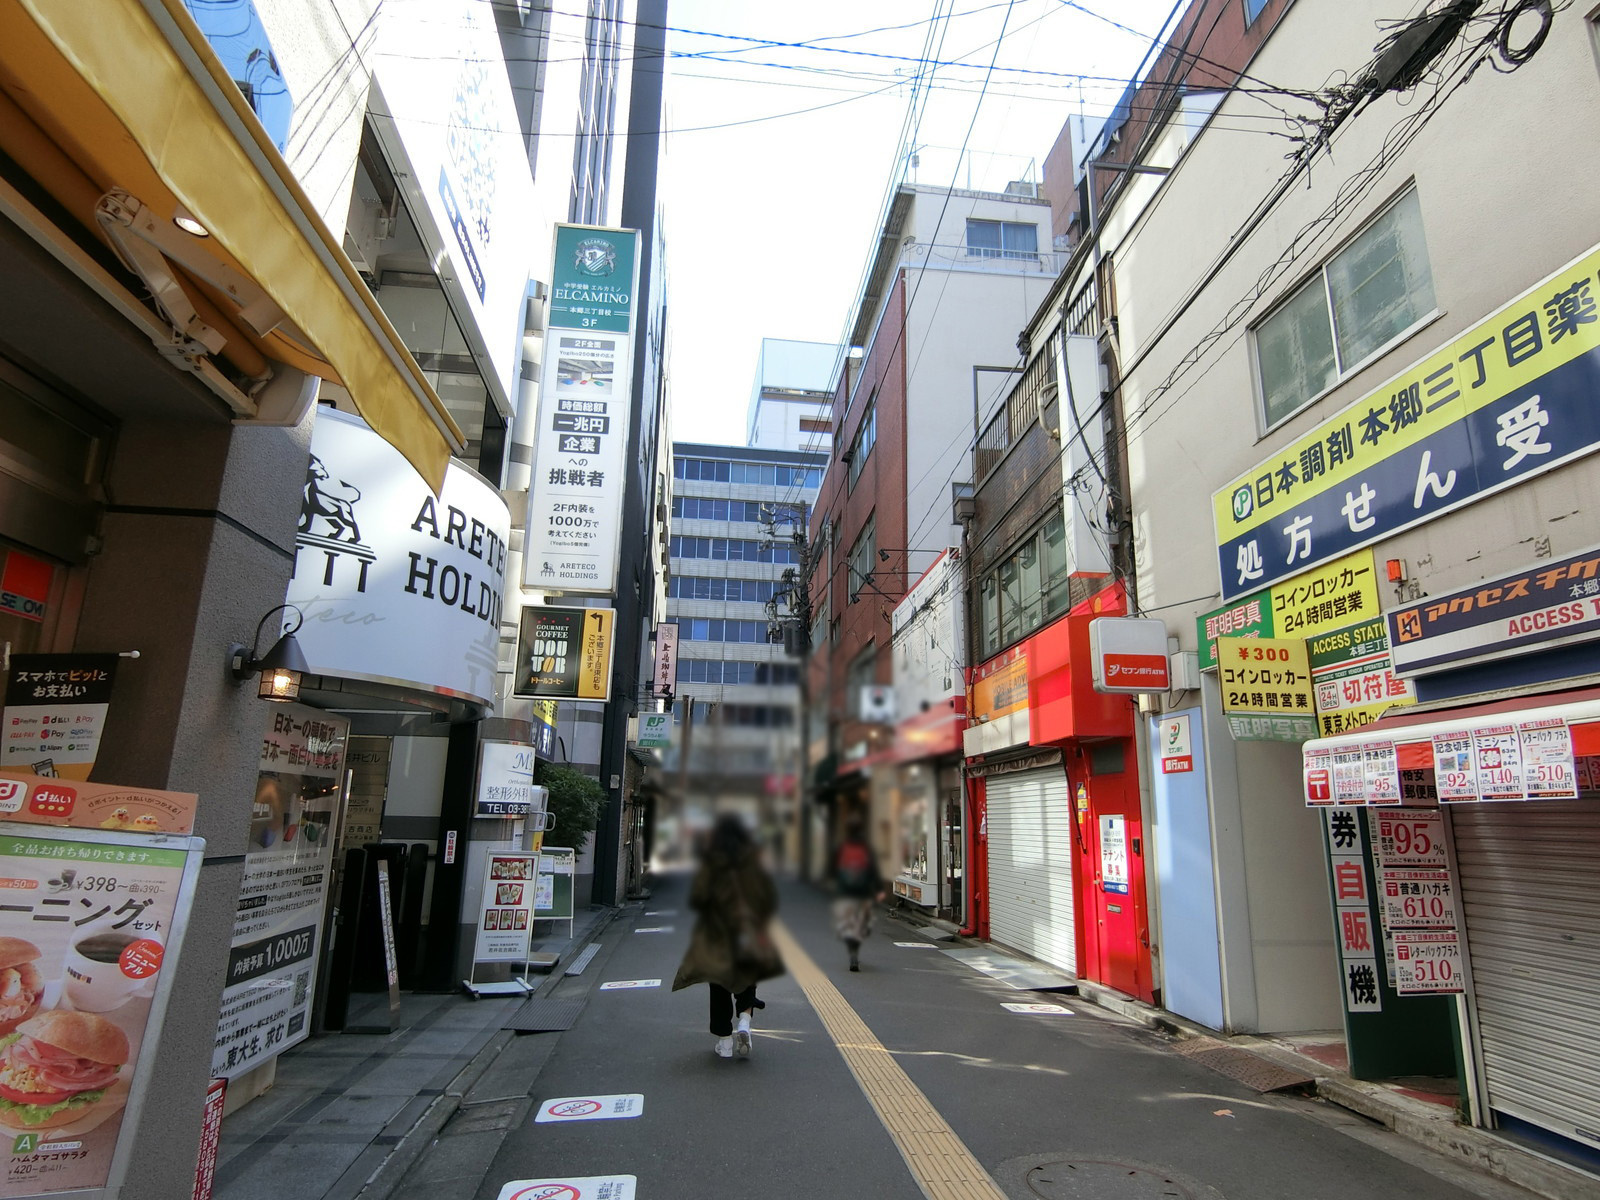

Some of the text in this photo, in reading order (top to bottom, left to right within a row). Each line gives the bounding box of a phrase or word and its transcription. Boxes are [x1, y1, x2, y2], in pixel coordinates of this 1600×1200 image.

[555, 288, 629, 305] ELCAMINO
[569, 306, 612, 317] 本郷三丁目校
[581, 318, 598, 327] 3F
[574, 339, 602, 349] 2F全面
[1254, 271, 1600, 509] 日本調剤 本郷三丁目薬
[561, 401, 605, 413] 時価総額
[557, 417, 605, 432] 一兆円
[563, 436, 596, 453] 企業
[568, 458, 588, 466] への
[548, 468, 605, 488] 挑戦者
[1236, 394, 1552, 586] 処方せん受
[552, 503, 595, 514] 2F内装を
[548, 516, 599, 528] 1000万で
[548, 530, 597, 539] 考えてください
[560, 562, 596, 570] ARETECO
[559, 572, 599, 580] HOLDINGS
[1275, 566, 1370, 613] コインロッカー
[1568, 577, 1600, 598] 本郷
[1424, 577, 1531, 622] アクセス
[1284, 590, 1364, 634] 24時間営業
[1508, 602, 1585, 636] ACCESS
[536, 624, 570, 632] GOURMET
[1205, 600, 1263, 641] 証明写真
[535, 631, 569, 639] COFFEE
[533, 639, 568, 657] DOU
[1313, 630, 1351, 656] ACCESS
[1238, 647, 1290, 662] ¥300
[16, 669, 109, 683] スマホでピッ!と
[1121, 666, 1165, 676] セブン銀行ATM
[1224, 668, 1307, 685] コインロッカー
[531, 676, 565, 685] ドトールコーヒー
[1342, 670, 1407, 704] 切符屋
[32, 683, 88, 698] お支払い
[1320, 690, 1337, 702] 24H
[1229, 692, 1308, 708] 24時間営業
[1322, 700, 1338, 708] OPEN
[1230, 717, 1315, 740] 証明写真
[1435, 741, 1471, 754] 記念切手
[1476, 735, 1516, 748] ミニシート
[1365, 749, 1395, 761] 普通切手
[1165, 759, 1189, 771] 銀行ATM
[1447, 772, 1475, 788] 92%
[1489, 768, 1520, 785] 140円
[1538, 764, 1573, 782] 510円
[1374, 777, 1398, 792] 95%
[1405, 784, 1437, 799] 郵便局
[36, 791, 72, 804] d払い
[486, 785, 529, 801] 整形外科
[487, 803, 506, 814] TEL
[1394, 823, 1445, 856] 95%
[12, 842, 153, 864] 全品お持ち帰りできます。
[1400, 882, 1451, 896] 普通ハガキ
[1331, 811, 1378, 1006] 券自販機
[1404, 896, 1454, 919] 610円
[132, 920, 162, 931] セット
[233, 931, 311, 978] 内装予算 1,000万
[1410, 945, 1459, 957] レターパックプラス
[126, 948, 158, 970] リニュー
[124, 961, 145, 976] アル
[1415, 959, 1462, 982] 510円
[17, 1135, 31, 1151] A
[10, 1149, 91, 1163] ハムタマゴサラダ
